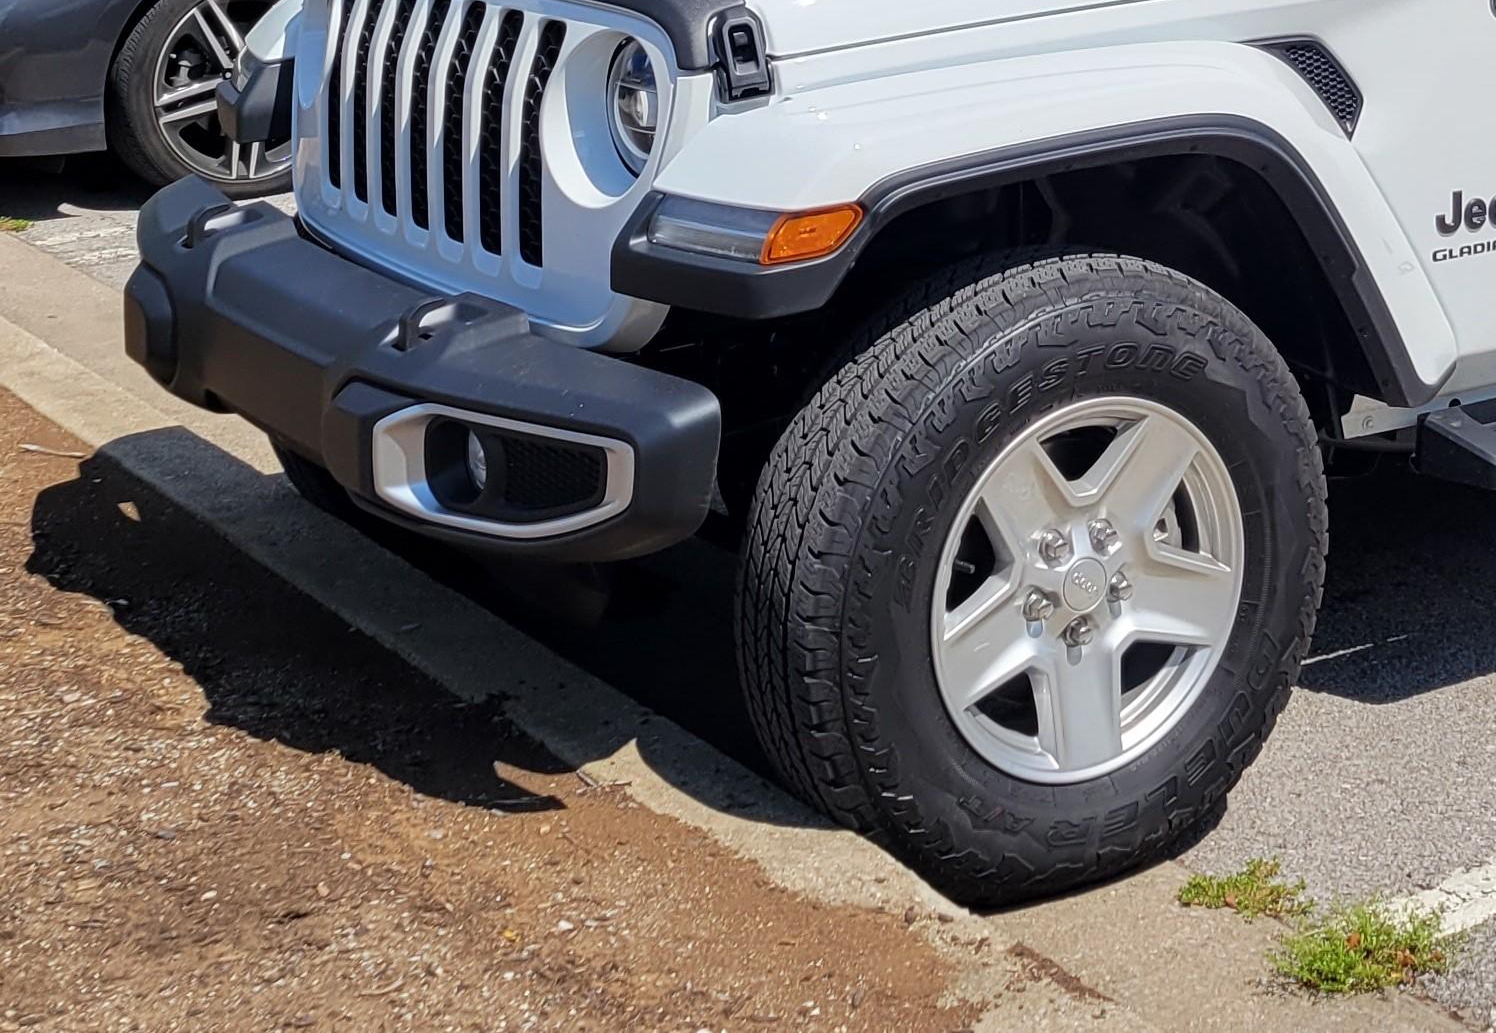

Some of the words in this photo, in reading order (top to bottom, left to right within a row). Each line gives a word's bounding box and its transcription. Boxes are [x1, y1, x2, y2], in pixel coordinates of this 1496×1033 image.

[894, 340, 1208, 612] BRIDGESTONE
[957, 793, 1036, 832] A/T
[1045, 628, 1280, 848] DUELER
